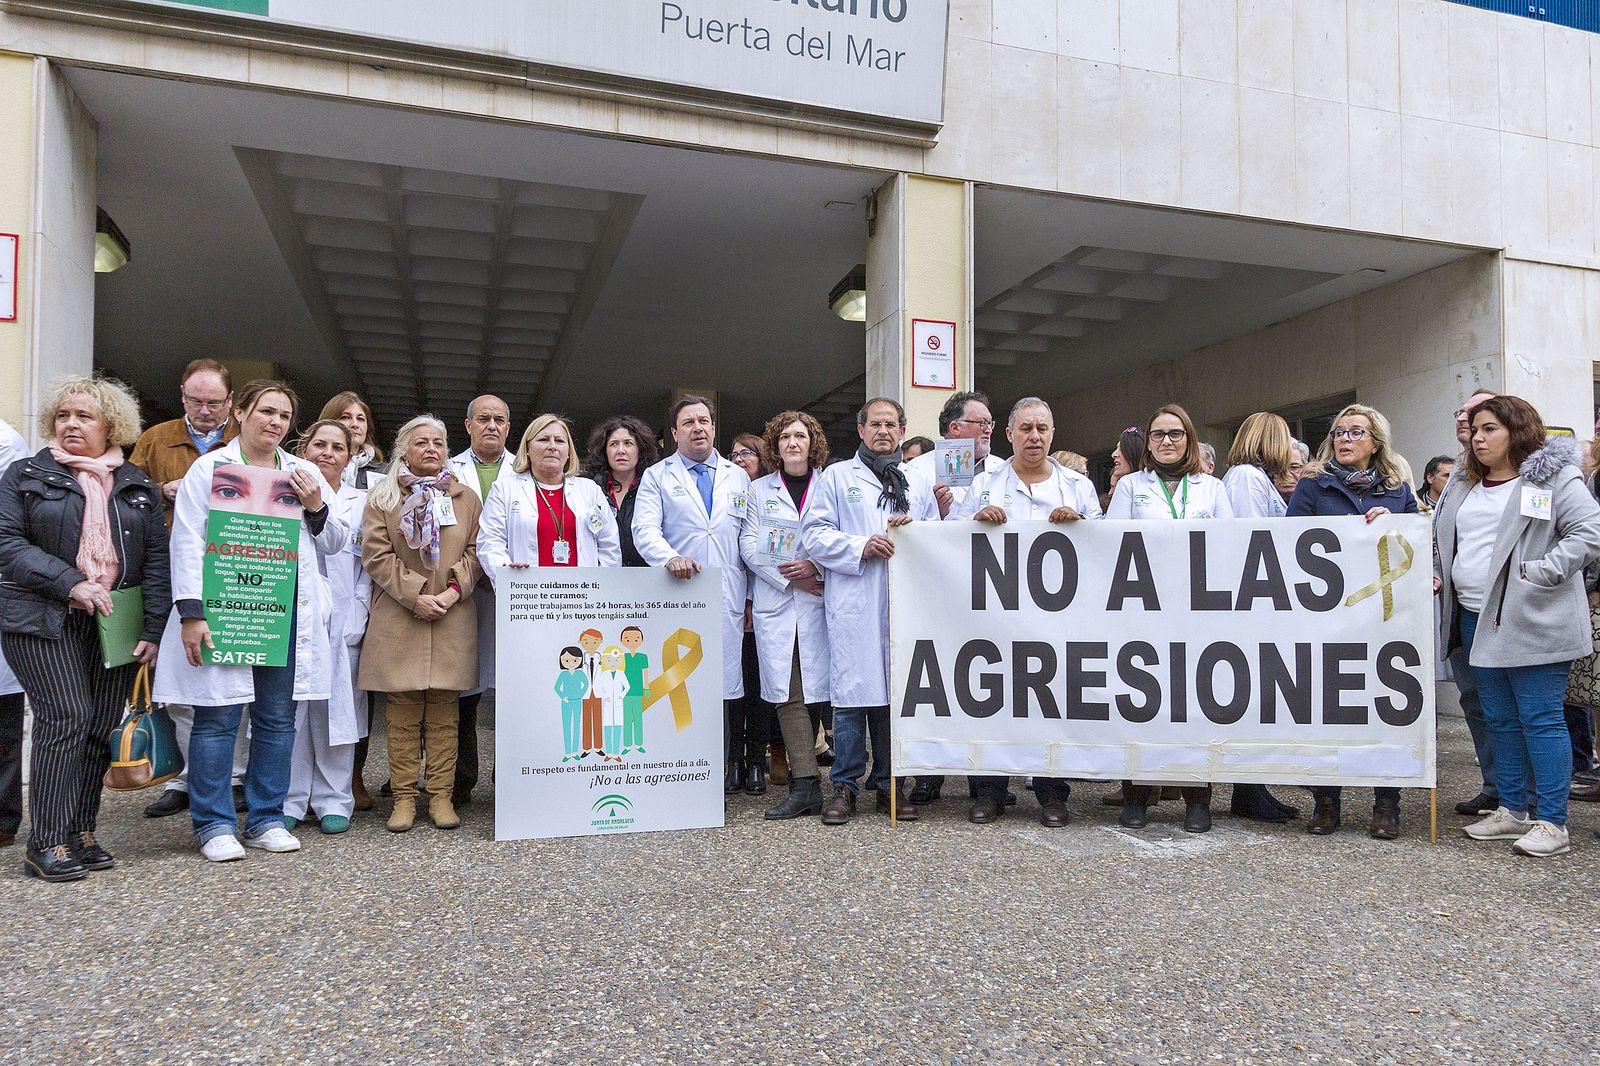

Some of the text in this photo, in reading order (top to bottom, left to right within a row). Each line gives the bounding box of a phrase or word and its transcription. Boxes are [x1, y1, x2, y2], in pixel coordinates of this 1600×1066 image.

[661, 2, 770, 51] Puerta
[786, 26, 831, 61] del
[846, 34, 906, 72] Mar
[267, 536, 291, 544] pasillo,
[204, 541, 298, 562] AGRESIÓN
[249, 563, 274, 571] todavía
[971, 528, 1345, 612] NO A LAS
[215, 569, 237, 577] toque,
[237, 572, 263, 586] NO
[240, 586, 273, 594] compartir
[510, 582, 538, 590] Porque
[591, 582, 600, 590] ti;
[227, 592, 263, 601] habitación
[510, 593, 538, 601] porque
[206, 599, 222, 609] ES
[226, 600, 287, 613] SOLUCIÓN
[540, 602, 582, 611] trabajamos
[663, 601, 679, 609] días
[680, 601, 691, 609] del
[218, 615, 250, 623] personal,
[510, 614, 528, 622] para
[574, 613, 596, 621] tuyos
[598, 612, 624, 620] tengáis
[211, 650, 267, 665] SATSE
[900, 639, 1424, 726] AGRESIONES
[521, 767, 530, 775] El
[532, 767, 564, 775] respeto
[578, 762, 629, 772] fundamental
[675, 760, 688, 768] día
[696, 758, 710, 767] día.
[590, 770, 711, 789] ¡No a las agresiones!
